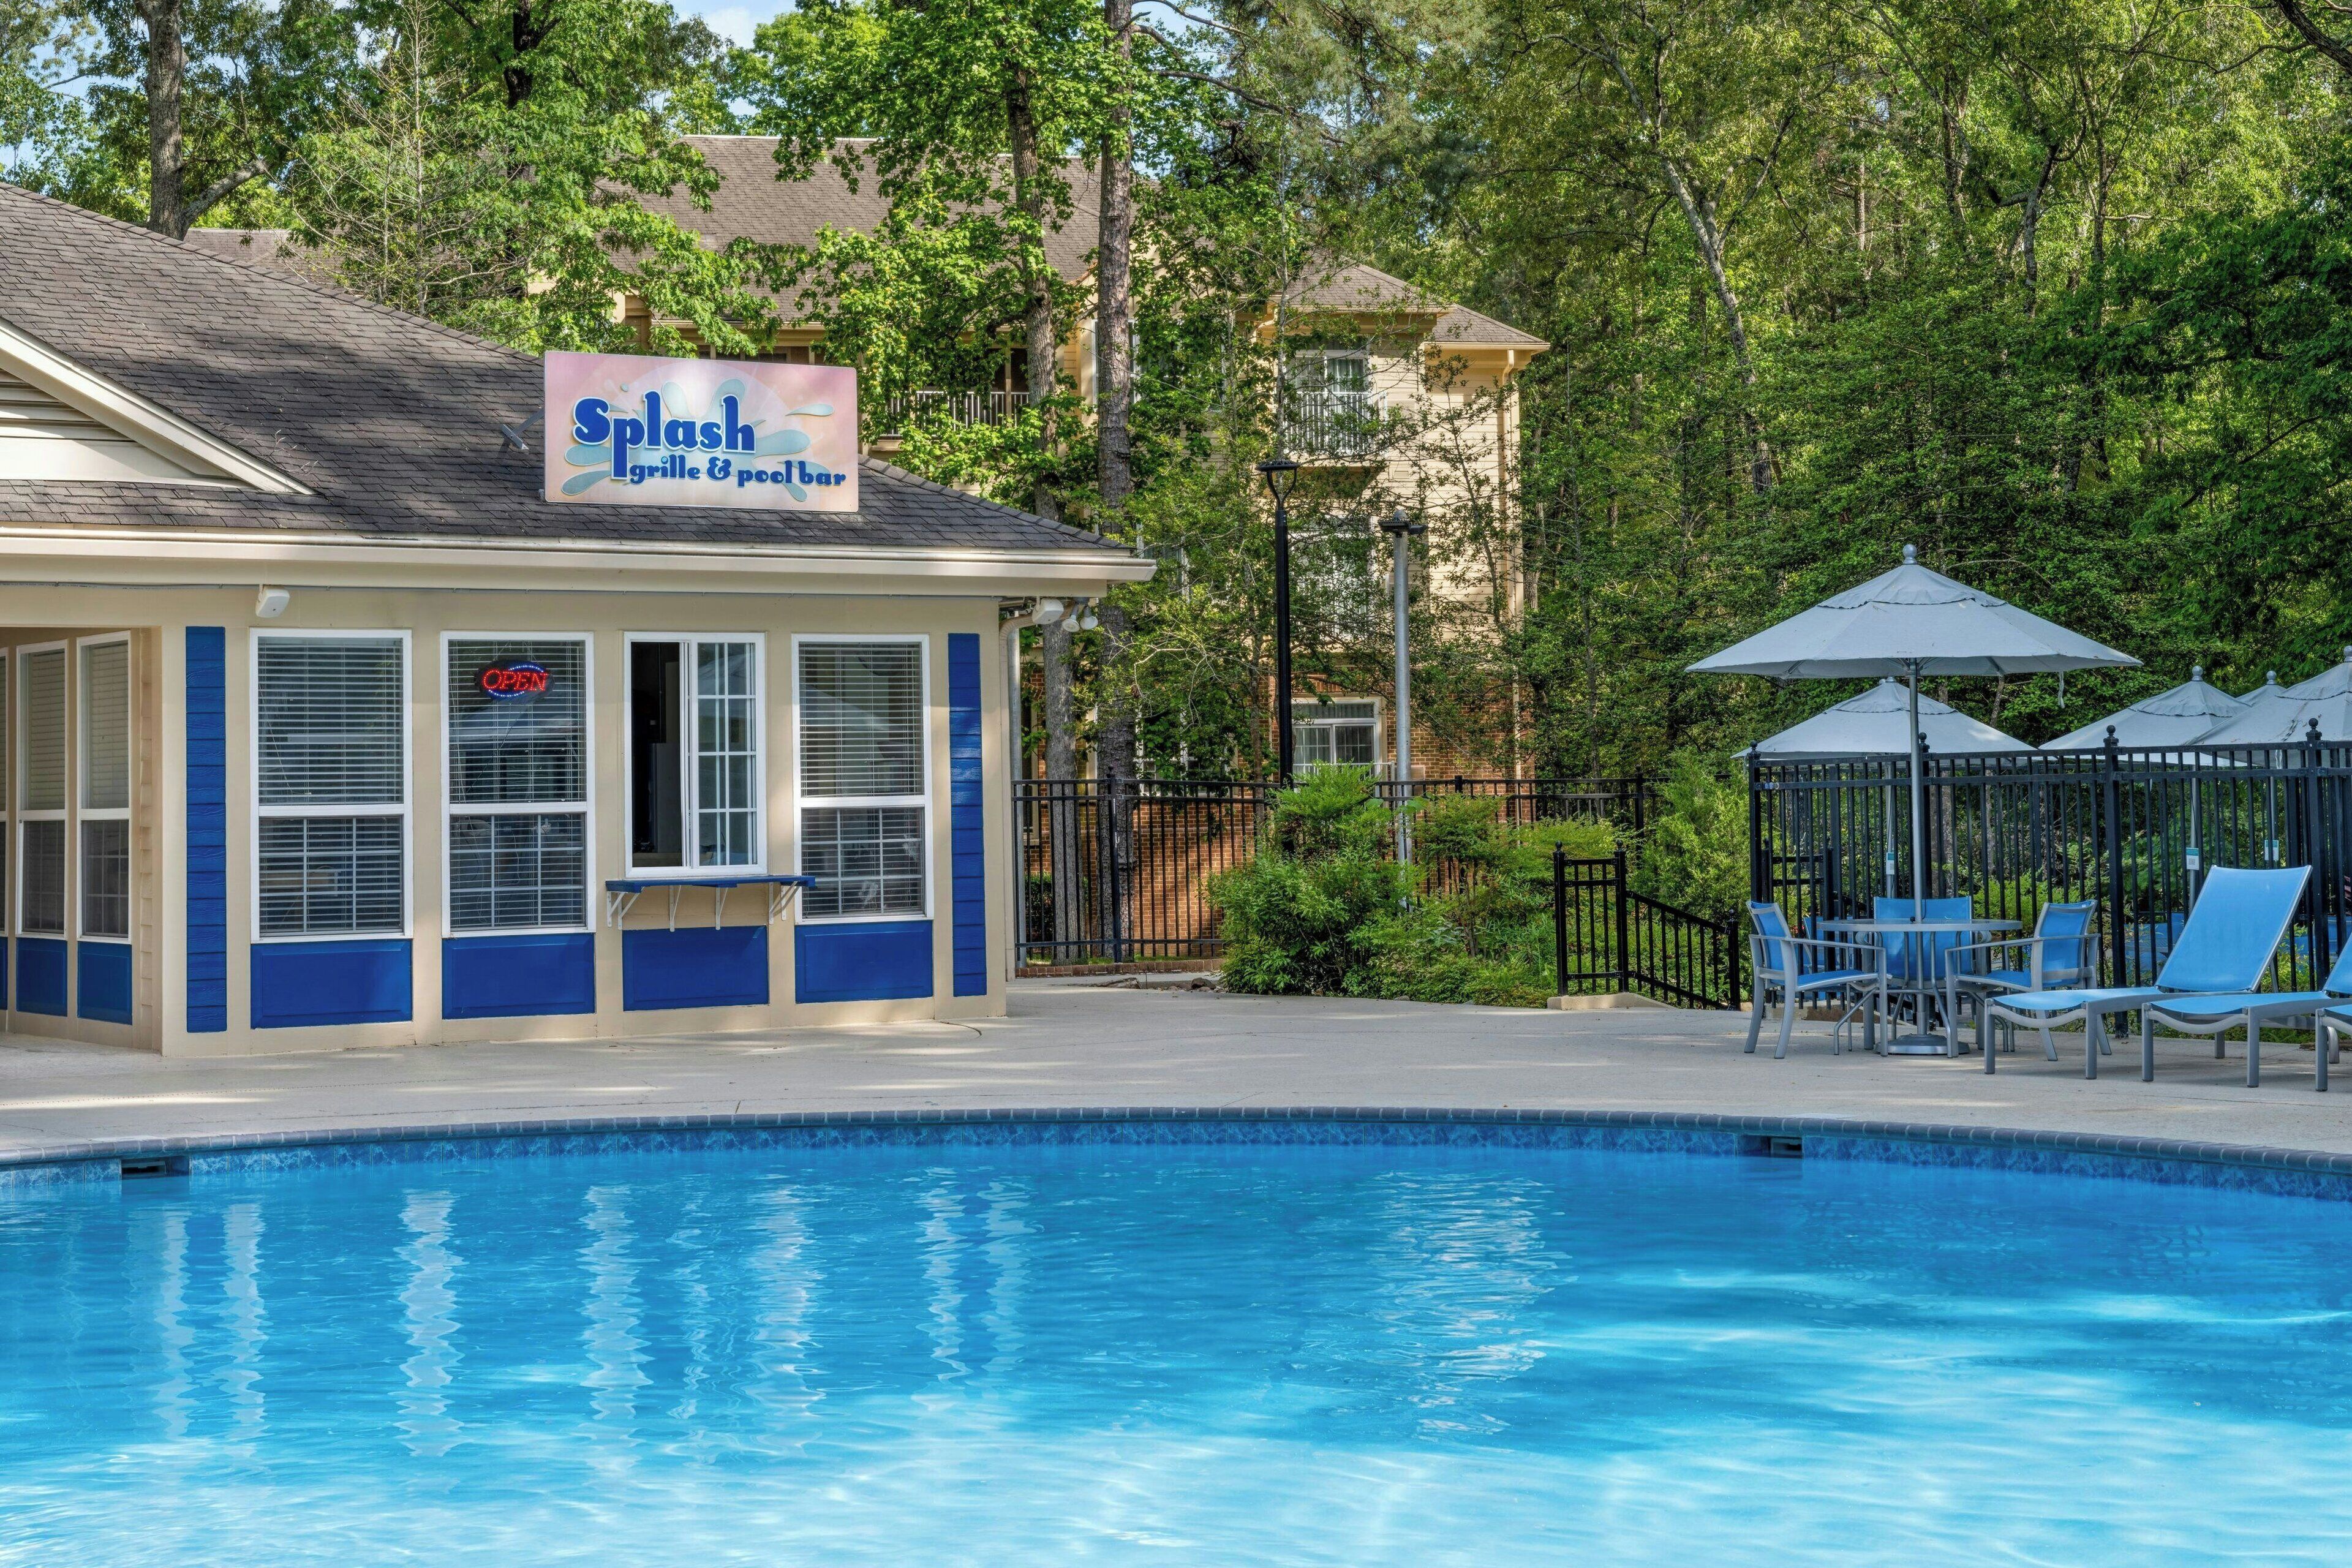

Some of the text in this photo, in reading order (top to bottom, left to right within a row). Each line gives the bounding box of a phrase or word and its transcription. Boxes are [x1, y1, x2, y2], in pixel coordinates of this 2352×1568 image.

[573, 391, 756, 479] Splash
[629, 454, 846, 488] grille & pool bar
[483, 668, 548, 692] OPEN
